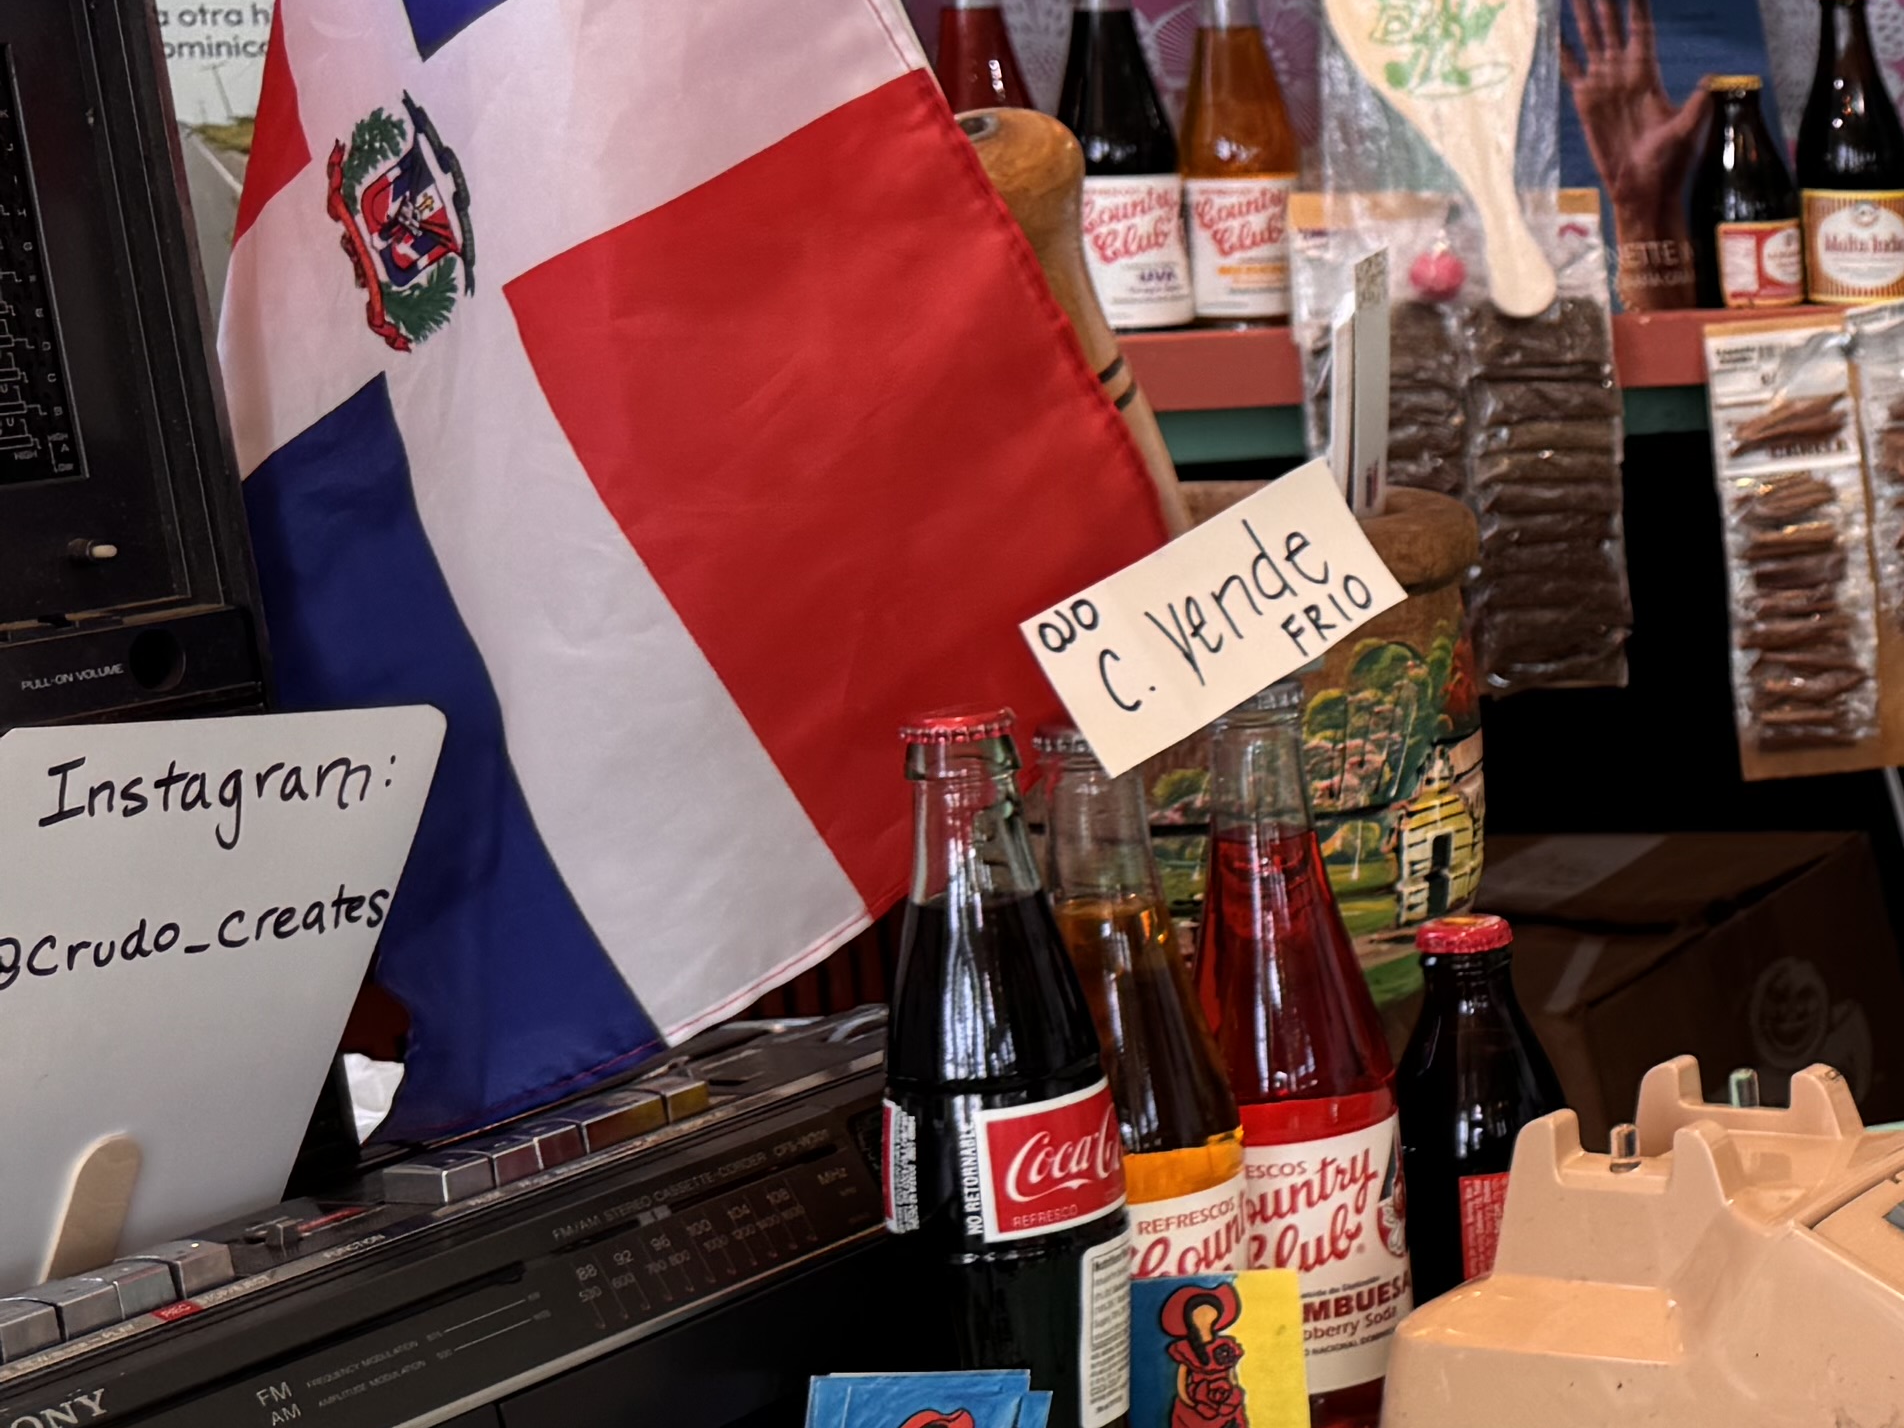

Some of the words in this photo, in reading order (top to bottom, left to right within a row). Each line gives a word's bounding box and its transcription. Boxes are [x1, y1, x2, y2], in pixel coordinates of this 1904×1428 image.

[179, 4, 243, 27] otra
[162, 34, 268, 59] ominica
[1093, 213, 1173, 266] Club
[1211, 212, 1285, 258] Club
[1145, 519, 1333, 686] Vende
[1281, 573, 1373, 657] FRIO
[21, 668, 75, 692] PULL-ON
[75, 663, 125, 683] VOLUME
[39, 753, 397, 850] Instagram:
[1245, 1160, 1307, 1180] ESCOS
[552, 1214, 602, 1242] FM/AM
[603, 1197, 650, 1222] STEREO
[966, 1214, 985, 1237] NO
[1012, 1204, 1079, 1229] REFRESCO
[1137, 1195, 1236, 1236] REFRESCOS
[576, 1262, 598, 1281] 88
[613, 1249, 634, 1267] 92
[726, 1203, 751, 1222] 104
[1303, 1275, 1411, 1323] MBUESA
[256, 1380, 293, 1407] FM
[270, 1402, 302, 1427] AM
